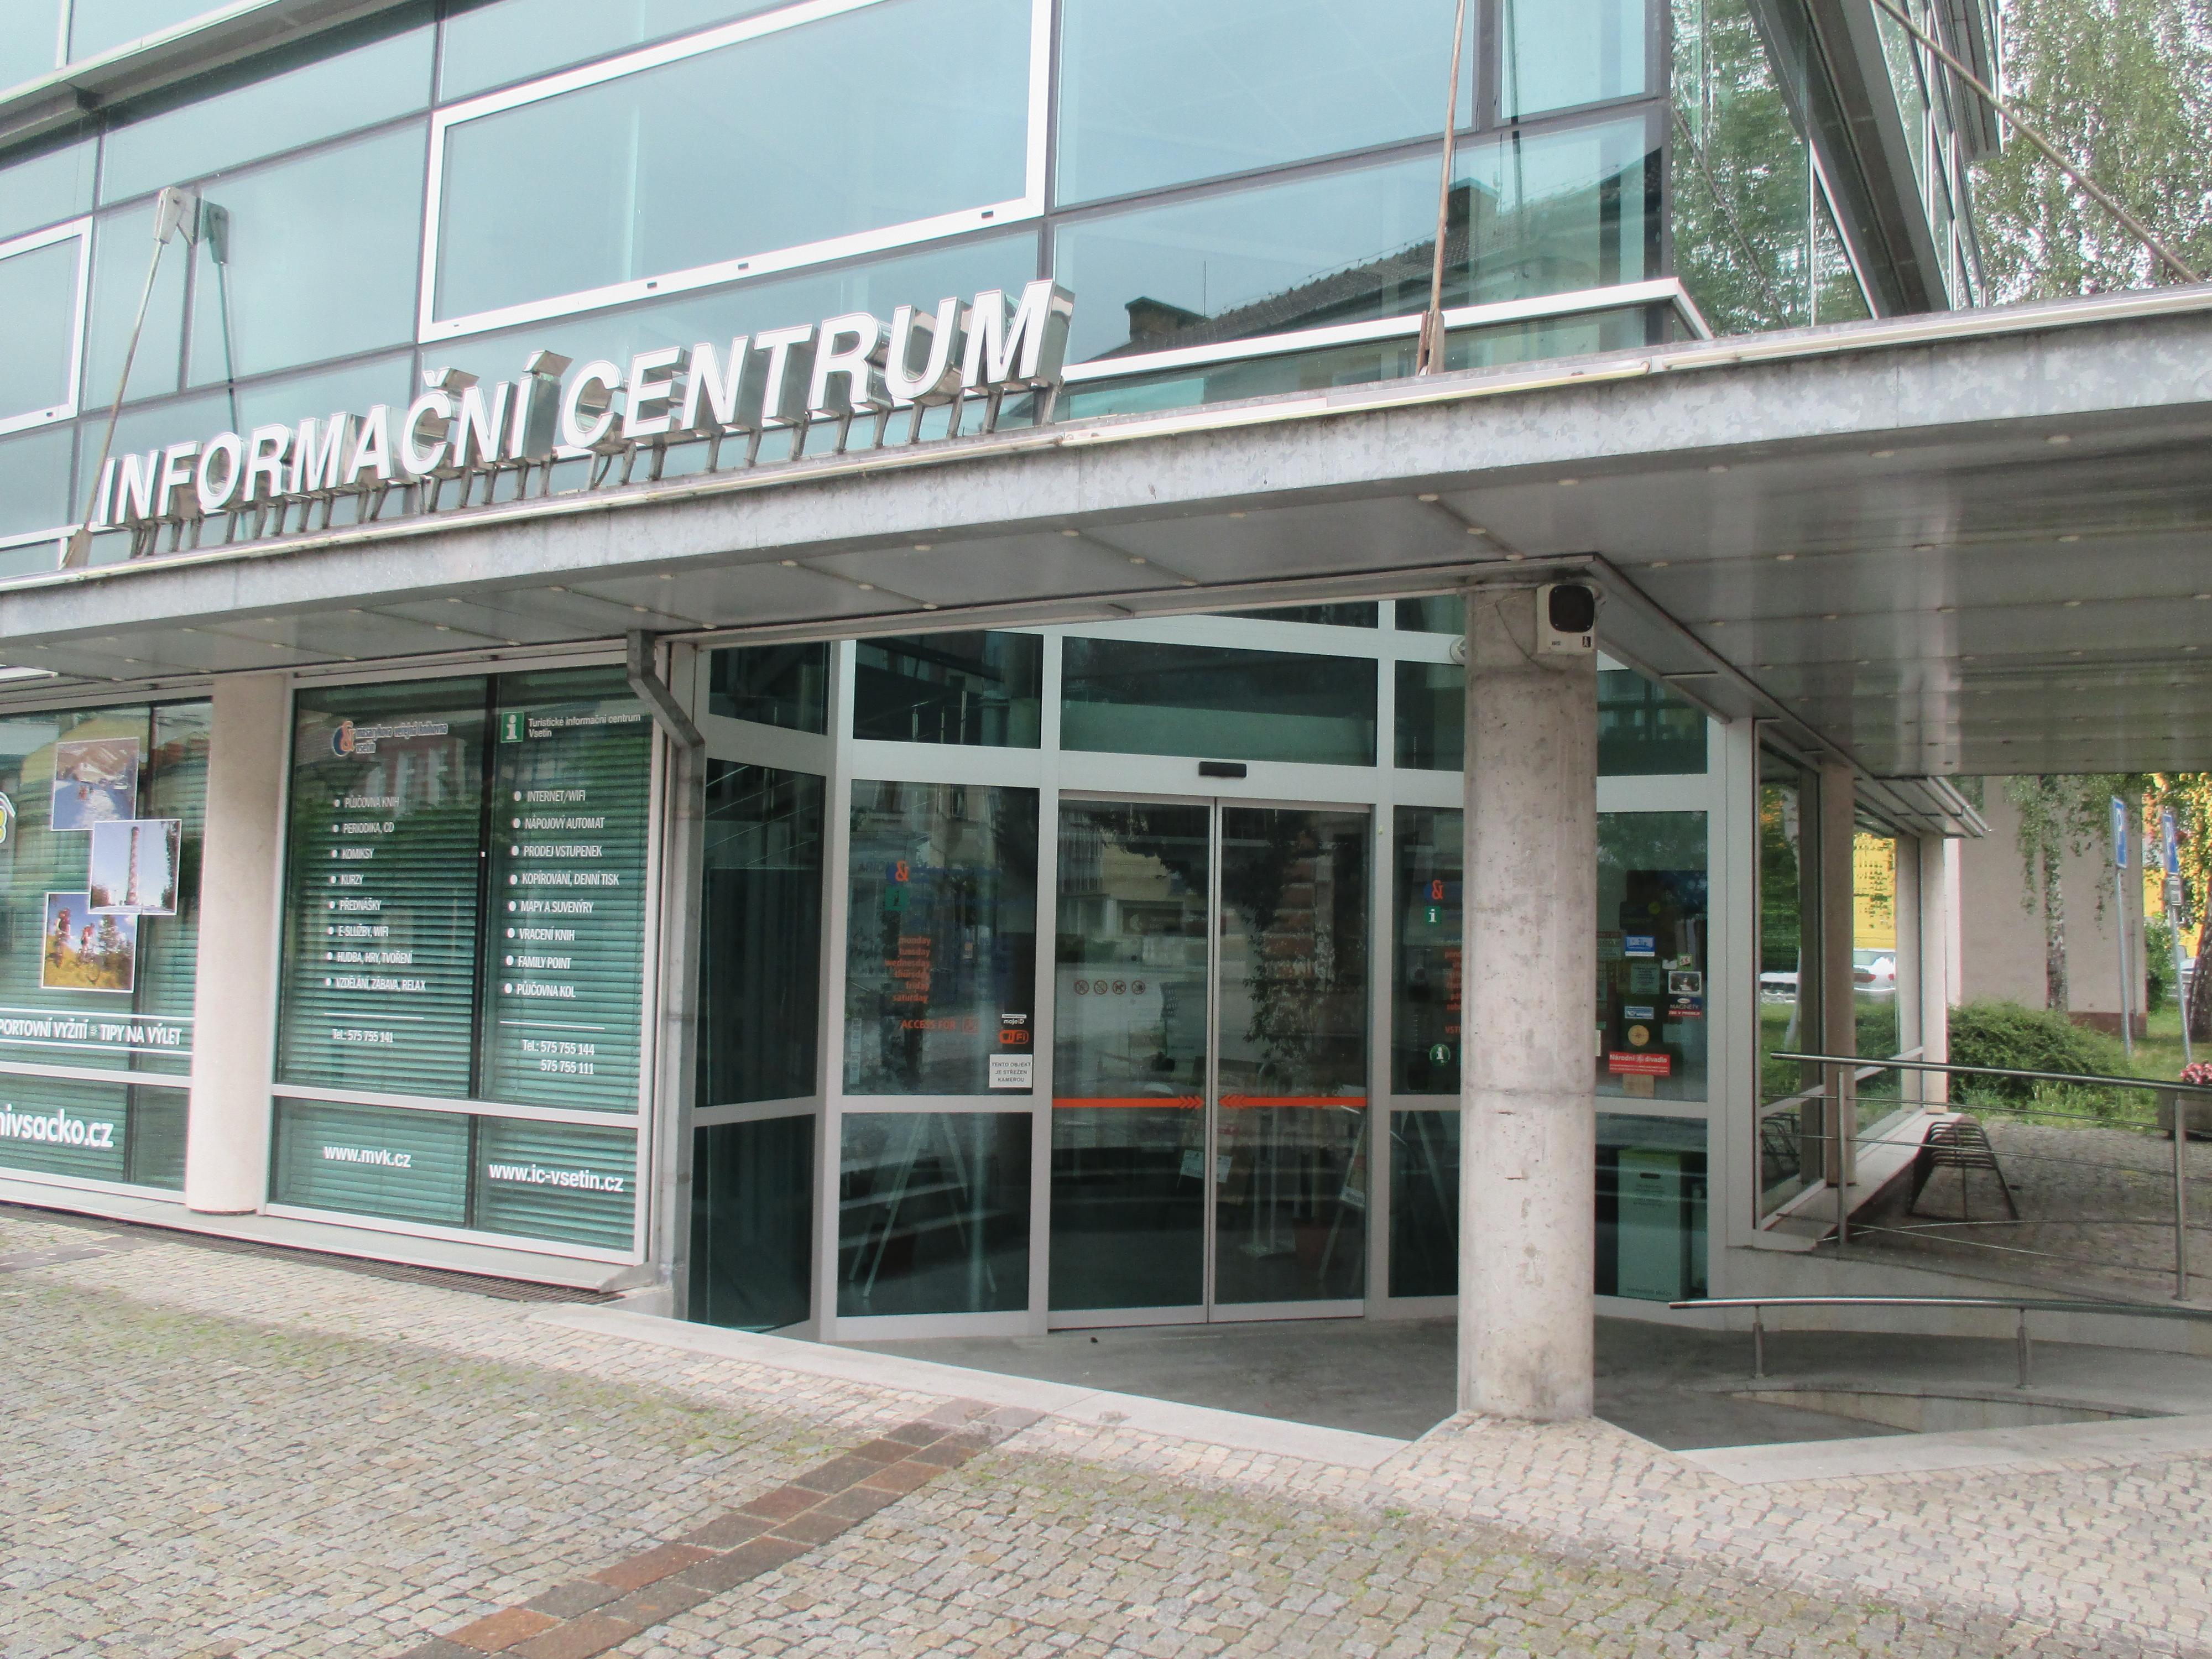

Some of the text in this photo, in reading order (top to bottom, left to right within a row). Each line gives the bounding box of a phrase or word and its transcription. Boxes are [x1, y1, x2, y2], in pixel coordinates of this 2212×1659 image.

[100, 279, 1057, 526] INFORMAČNÍ CENTRUM
[529, 717, 564, 728] Turistické
[609, 713, 641, 723] centrum
[529, 728, 552, 738] Vsetín
[382, 796, 400, 807] KNIH
[527, 790, 586, 804] INTERNET/WIFI
[383, 822, 395, 833] CD
[525, 814, 605, 829] NÁPOJOVÝ AUTOMAT
[342, 848, 375, 859] KOMIKSY
[524, 845, 603, 857] PRODEJ VSTUPENEK
[341, 874, 364, 885] KURZY
[521, 870, 619, 887] KOPÍROVÁNÍ, DENNÍ TISK
[339, 898, 382, 911] PŘEDNÁŠKY
[520, 899, 594, 913] MAPY A SUVENÝRY
[338, 923, 389, 938] E-SLUŽBY, WIFI
[519, 926, 575, 941] VRACENÍ KNIH
[899, 936, 931, 946] monday
[337, 950, 413, 964] HUDBA, HRY, TVOŘENÍ
[899, 948, 931, 958] tuesday
[518, 956, 572, 969] FAMILY POINT
[885, 959, 930, 969] wednesday
[894, 969, 930, 980] thursday
[336, 975, 426, 992] VZDĚLÁNÍ, ZÁBAVA, RELAX
[516, 980, 576, 998] PŮJČOVNA KOL
[905, 980, 930, 992] friday
[893, 994, 929, 1004] saturday
[901, 1019, 956, 1030] ACCESS FOR
[54, 1018, 89, 1040] VYŽITÍ
[100, 1024, 126, 1041] TIPY
[126, 1025, 145, 1044] NA
[147, 1022, 183, 1046] VÝLET
[348, 1030, 362, 1041] 575
[363, 1030, 379, 1042] 755
[380, 1032, 394, 1043] 141
[522, 1039, 595, 1055] Tel.: 575 755 144
[1645, 1055, 1668, 1063] divadlo
[540, 1060, 594, 1074] 575 755 111
[323, 1146, 411, 1168] www.mvk.cz
[488, 1164, 624, 1192] www.ic-vsetin.cz
